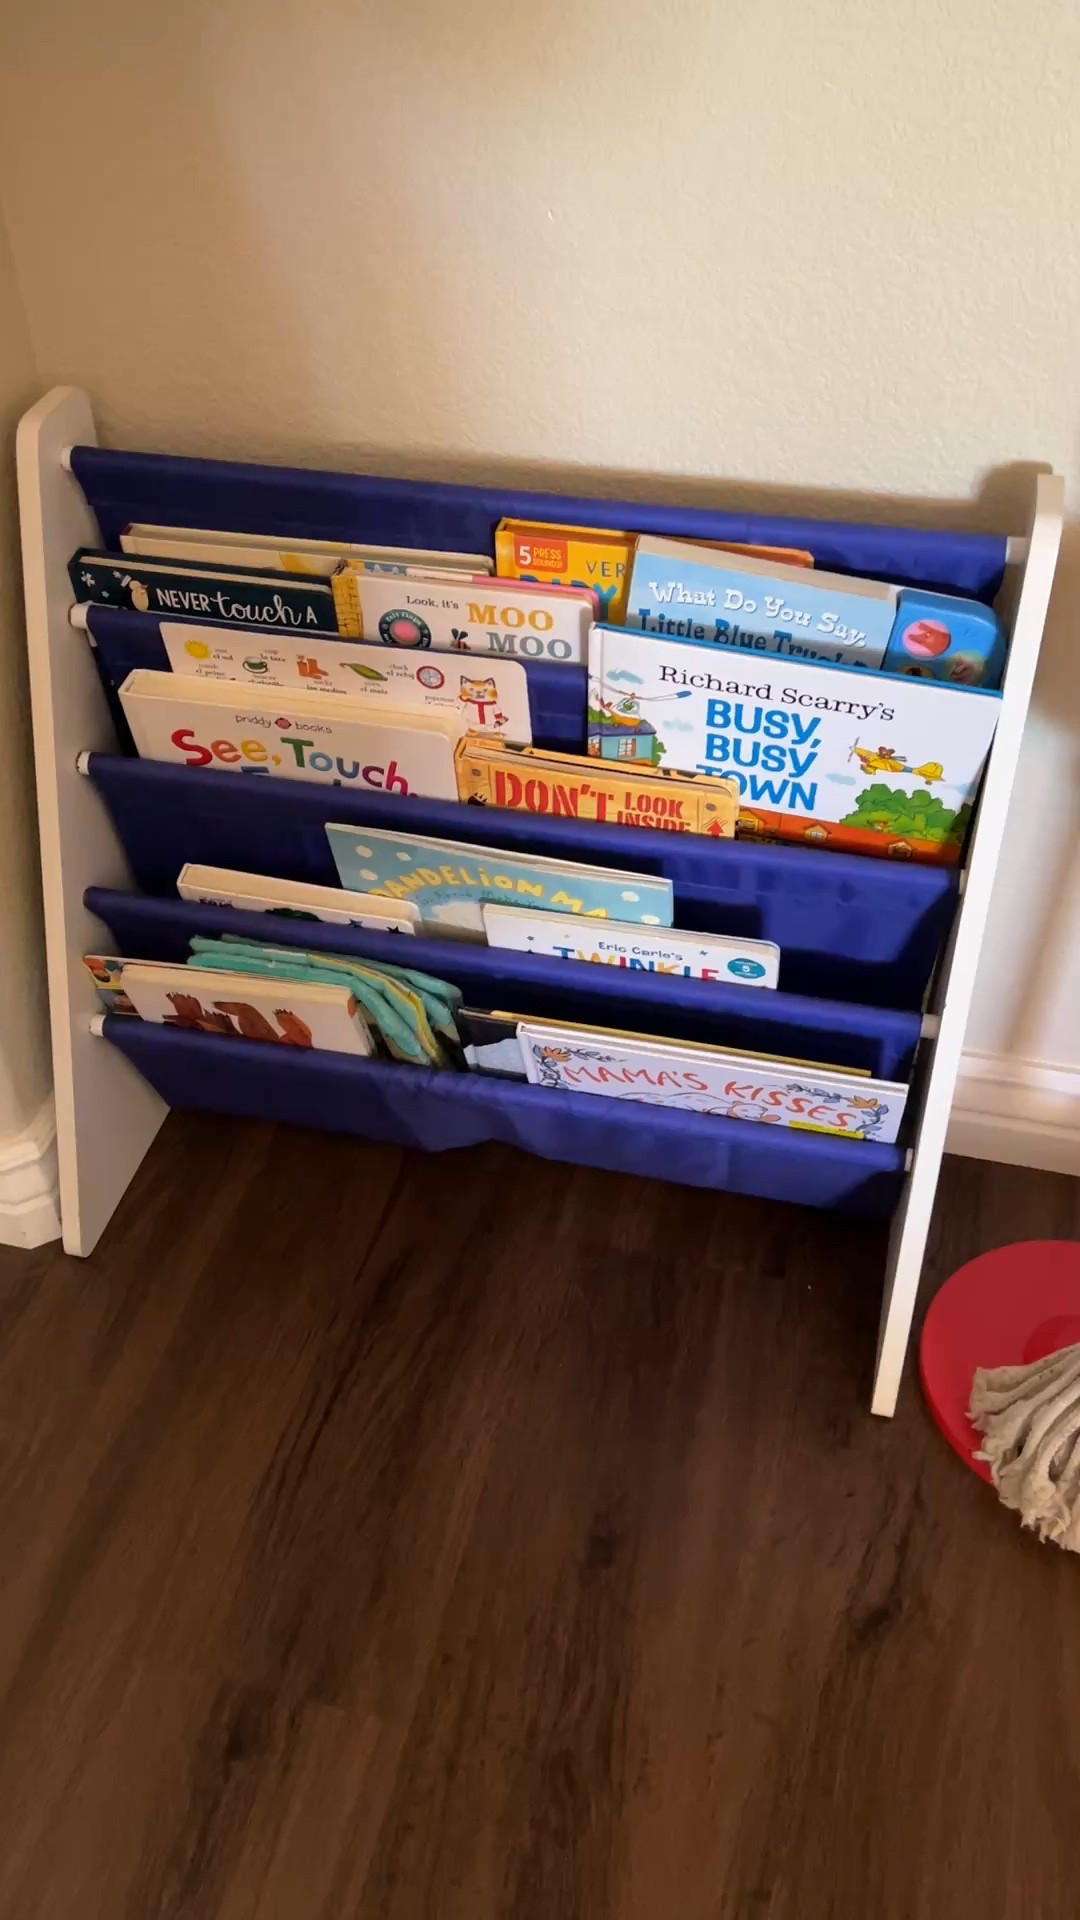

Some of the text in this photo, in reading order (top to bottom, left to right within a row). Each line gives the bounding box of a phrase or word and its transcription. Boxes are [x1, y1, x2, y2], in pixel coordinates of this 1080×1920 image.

[519, 545, 562, 565] 5 PRESS
[156, 588, 318, 626] NEVER touch A
[405, 595, 554, 632] Look, it's MOO
[648, 581, 716, 607] What
[723, 588, 757, 613] Do
[764, 595, 813, 628] You
[486, 631, 573, 660] MOO
[638, 608, 705, 640] Little
[712, 618, 767, 650] Blue
[658, 665, 896, 722] Richard Scarry's
[235, 714, 333, 734] priddy books
[705, 697, 822, 749] BUSY,
[170, 728, 282, 766] See,
[704, 733, 819, 779] BUSY
[494, 770, 685, 824] DON'T LOOK
[598, 941, 684, 962] Eric Carle's
[562, 1063, 857, 1128] MAMA'S KISSES
